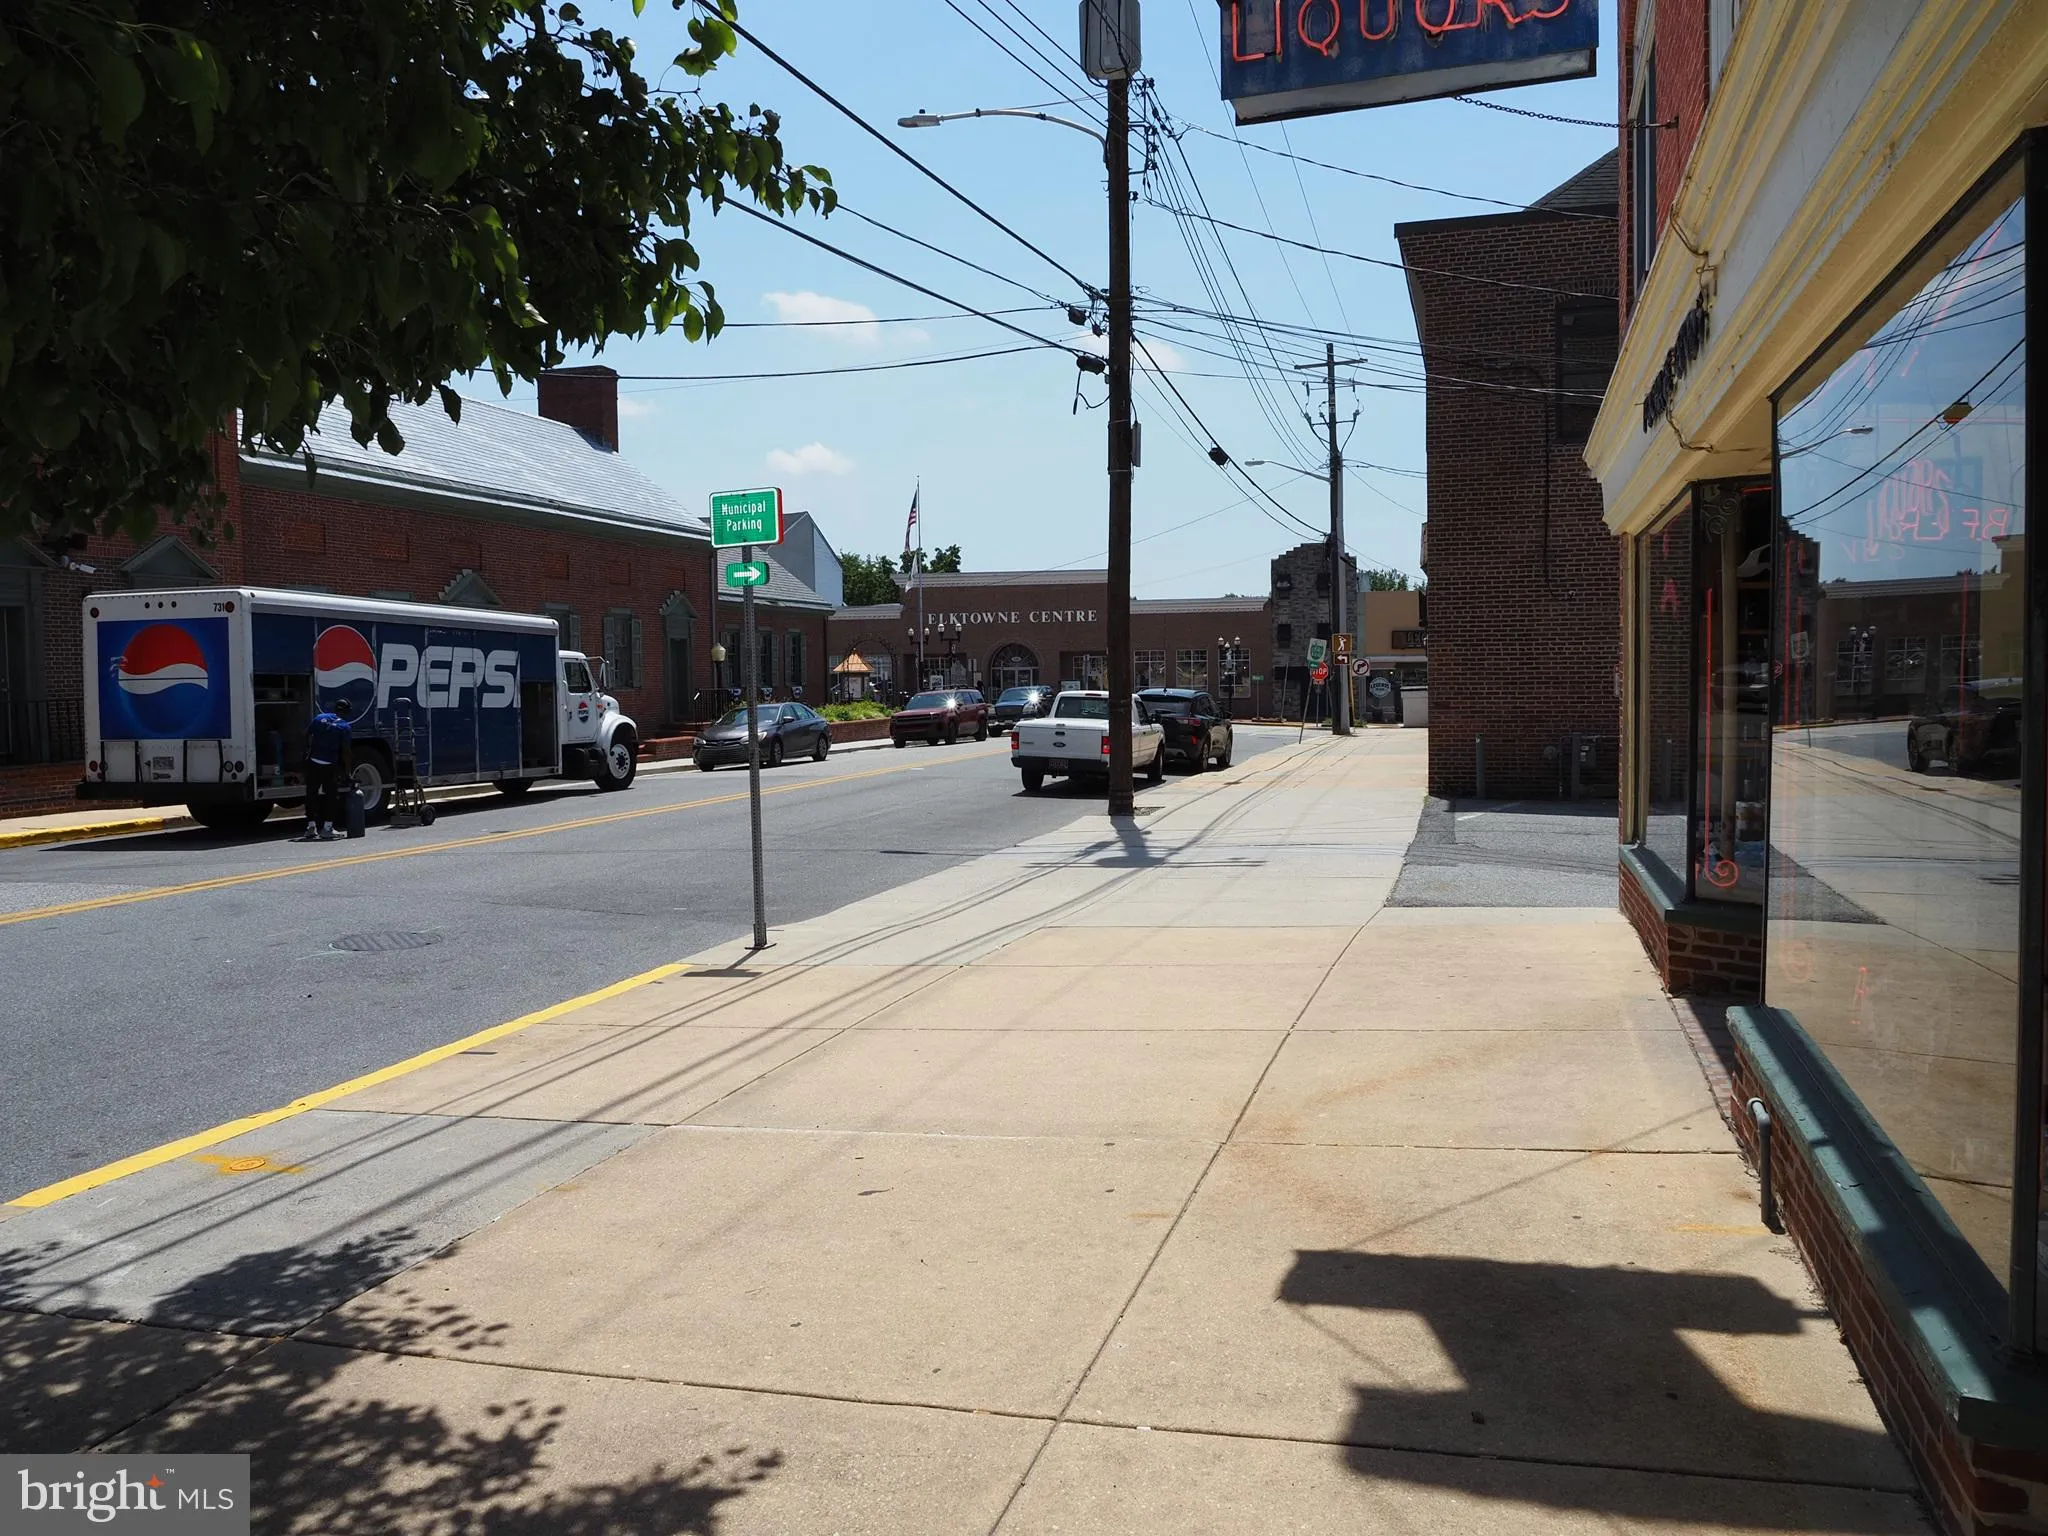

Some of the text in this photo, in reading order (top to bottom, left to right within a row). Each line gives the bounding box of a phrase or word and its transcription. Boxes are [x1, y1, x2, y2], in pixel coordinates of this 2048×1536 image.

[1232, 0, 1570, 61] LIQUO
[721, 500, 766, 516] Municipal
[726, 518, 762, 532] Parking
[928, 609, 1097, 625] ELKTOWNE CENTRE
